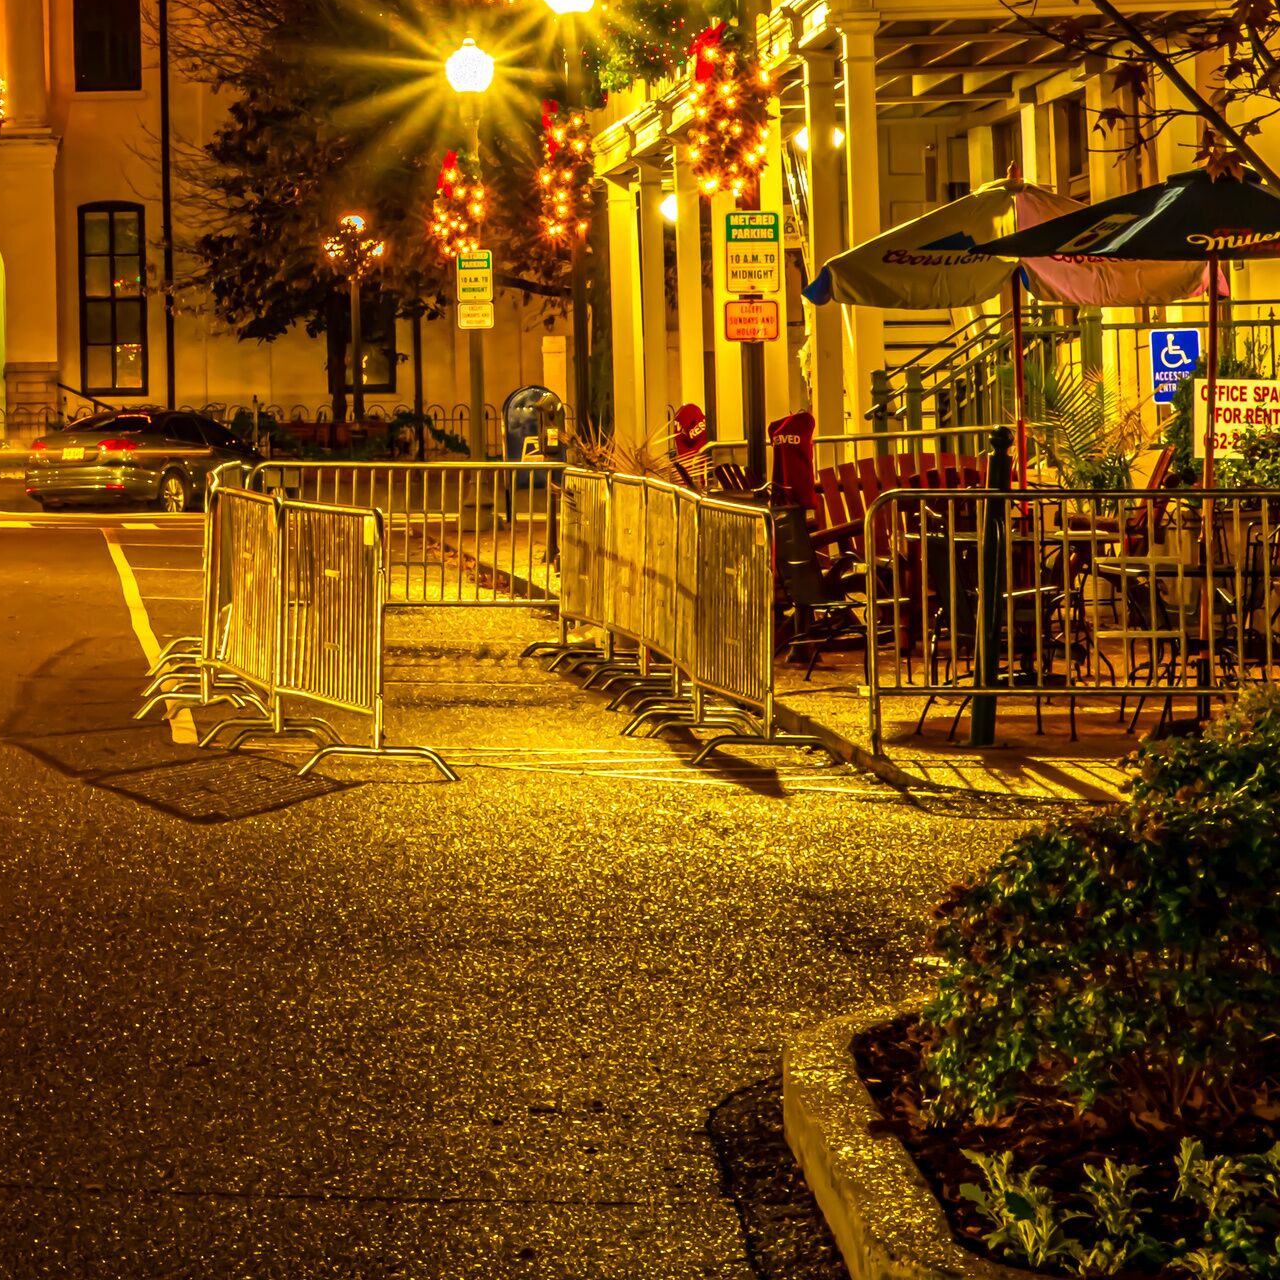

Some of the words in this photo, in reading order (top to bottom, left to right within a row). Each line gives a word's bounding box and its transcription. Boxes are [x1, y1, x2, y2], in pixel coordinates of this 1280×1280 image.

[730, 215, 776, 226] METERED
[731, 228, 774, 239] PARKING
[1186, 231, 1280, 252] Miller
[730, 254, 740, 264] 10
[765, 254, 775, 263] TO
[881, 249, 943, 266] Coors
[731, 269, 774, 279] MIDNIGHT
[736, 327, 767, 336] HOLIDS
[1253, 386, 1280, 403] SPA
[1215, 407, 1242, 424] FOR
[1245, 407, 1280, 425] RENT
